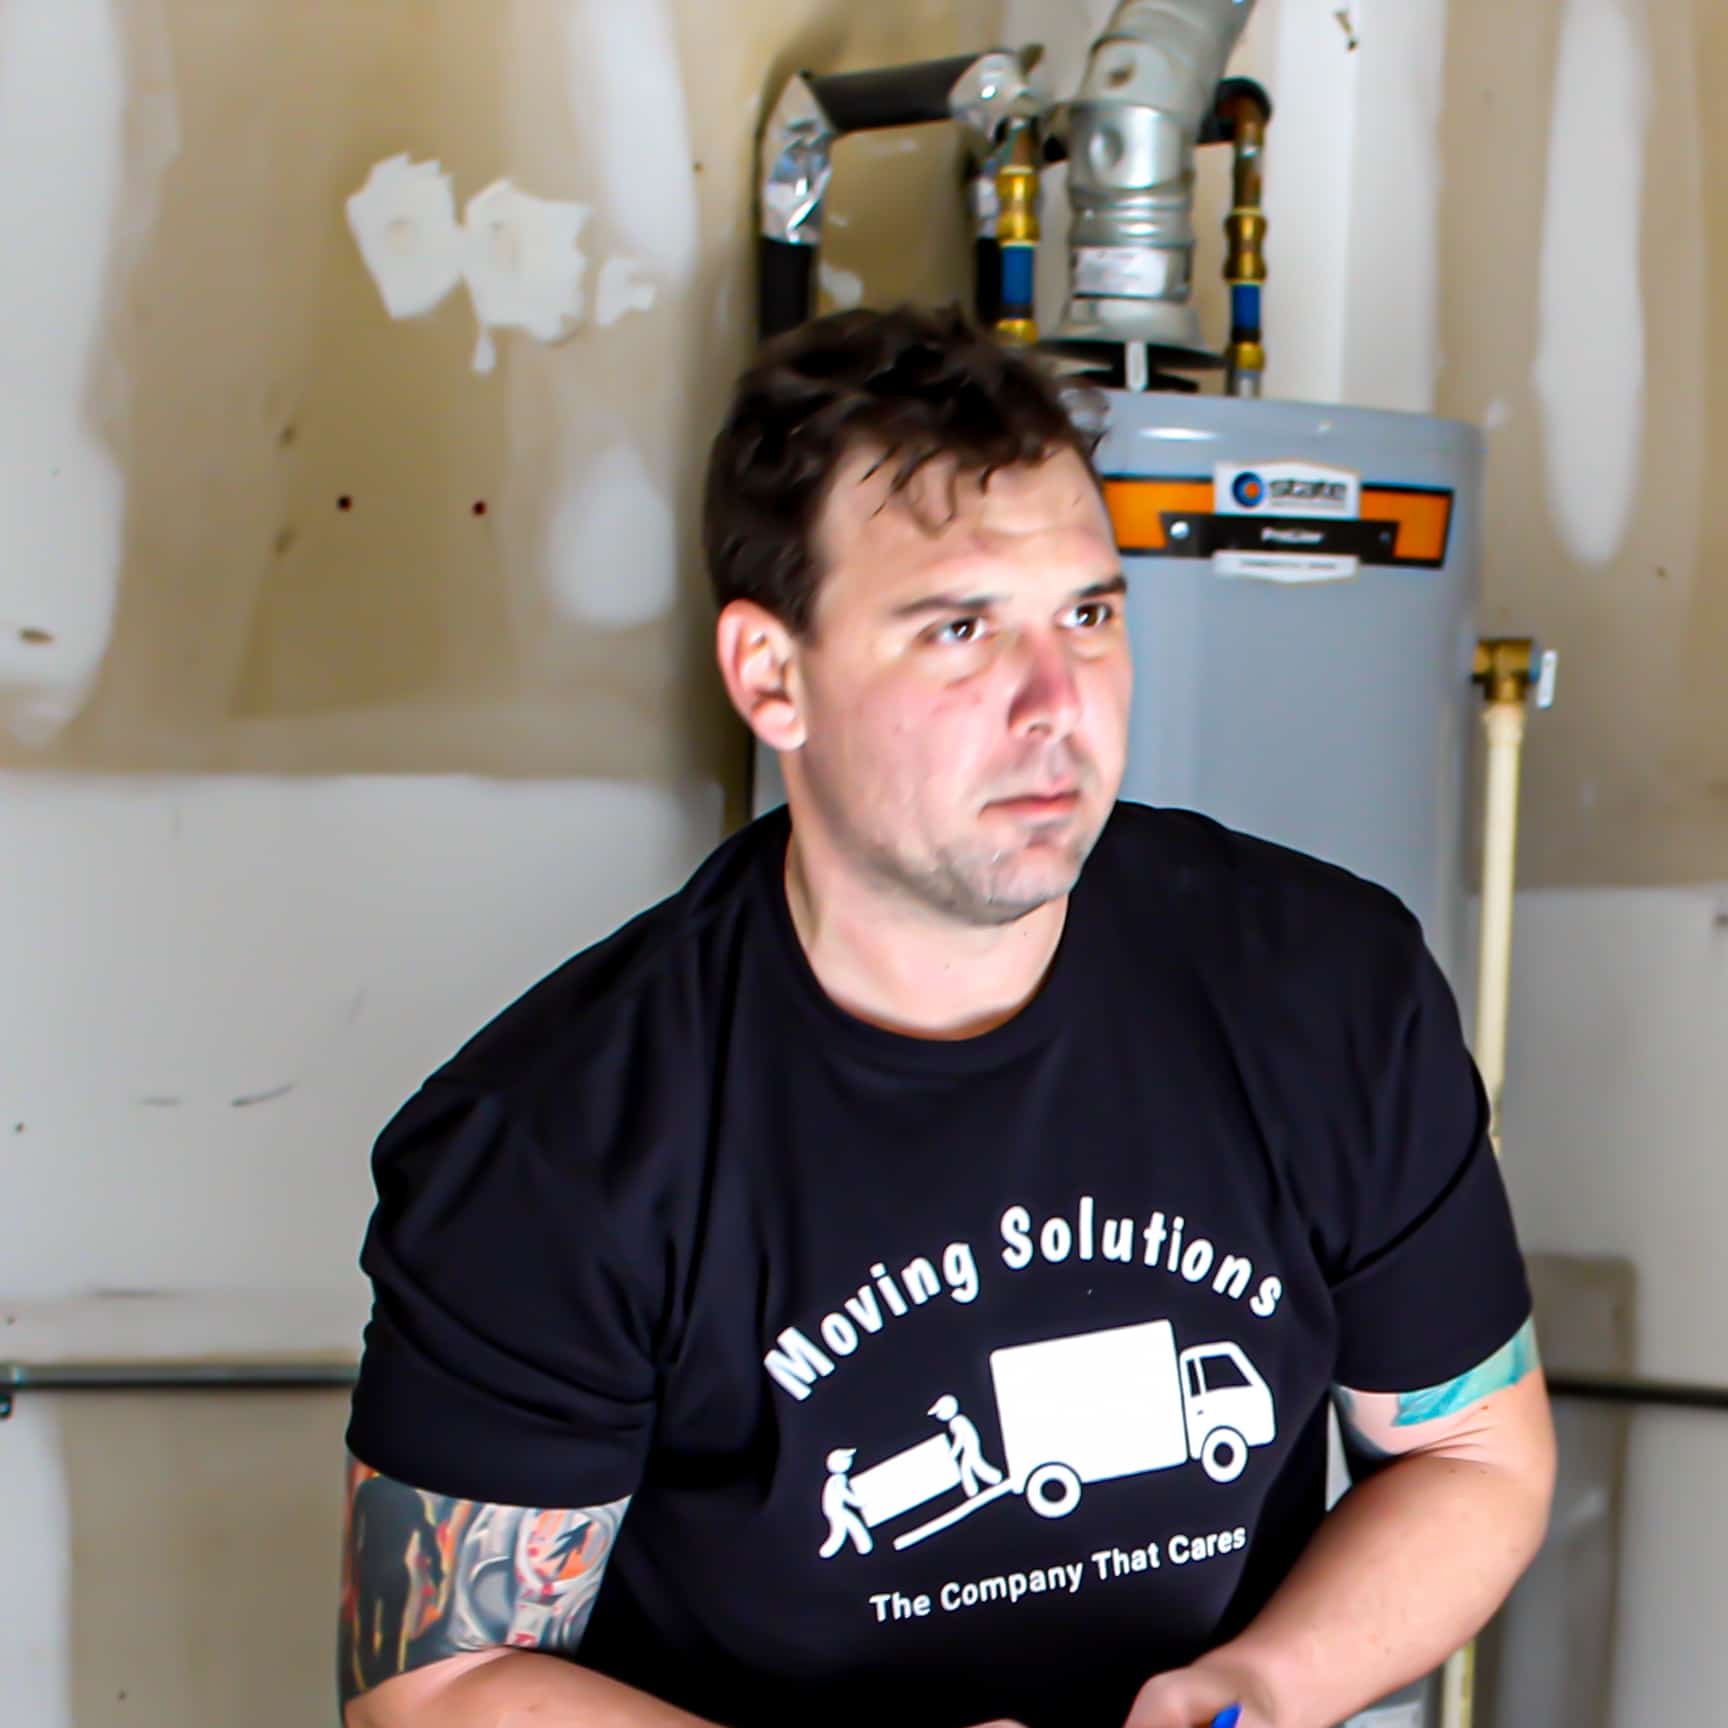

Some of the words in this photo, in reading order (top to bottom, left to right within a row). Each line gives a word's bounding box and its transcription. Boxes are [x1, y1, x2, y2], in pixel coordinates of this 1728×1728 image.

[762, 1241, 980, 1402] Moving
[999, 1195, 1283, 1318] Solutions
[868, 1592, 931, 1622] The
[939, 1561, 1084, 1612] Company
[1091, 1543, 1160, 1580] That
[1167, 1527, 1247, 1564] Cares
